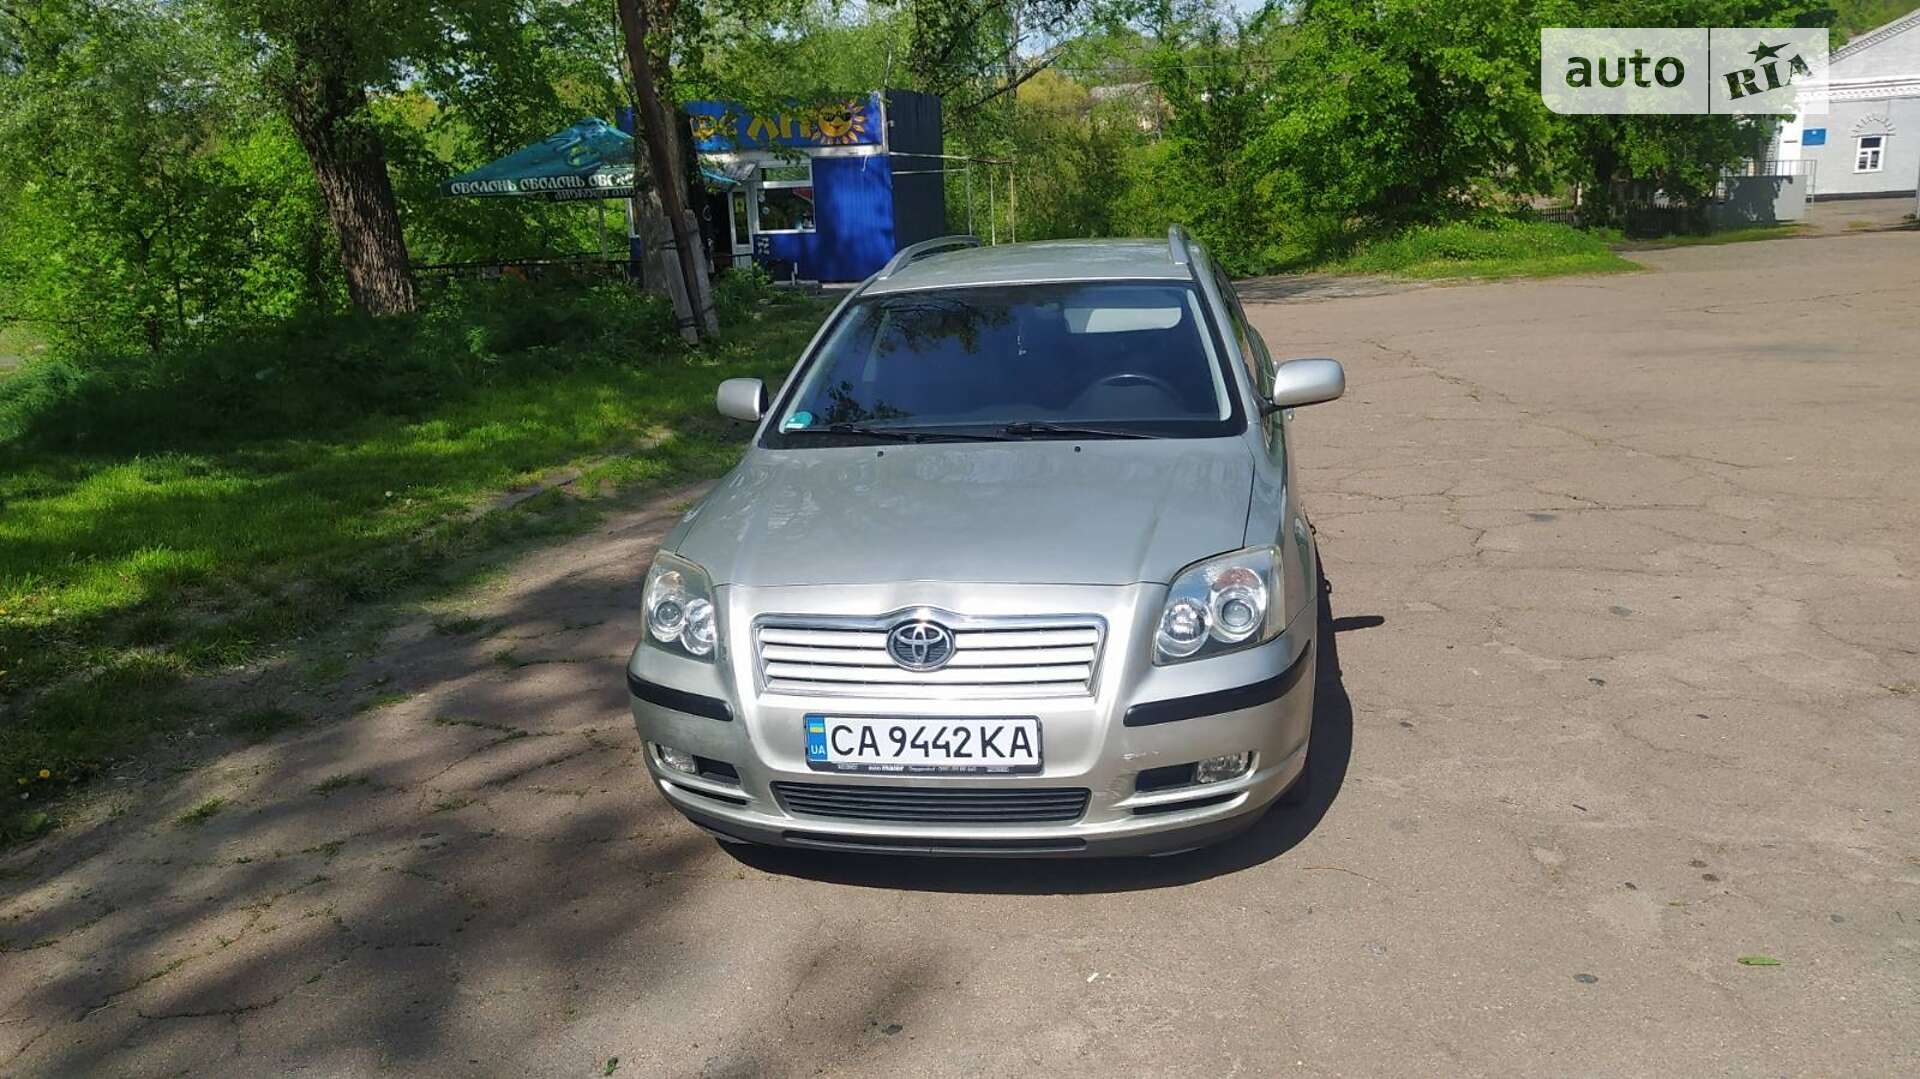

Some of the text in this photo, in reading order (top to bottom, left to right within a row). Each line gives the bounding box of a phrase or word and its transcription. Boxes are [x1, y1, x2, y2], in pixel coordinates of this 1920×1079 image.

[450, 179, 517, 195] ОБОЛОНЬ
[520, 174, 585, 191] ОБОЛОНЬ
[811, 744, 826, 756] UA
[831, 725, 1033, 758] CA 9442 KA
